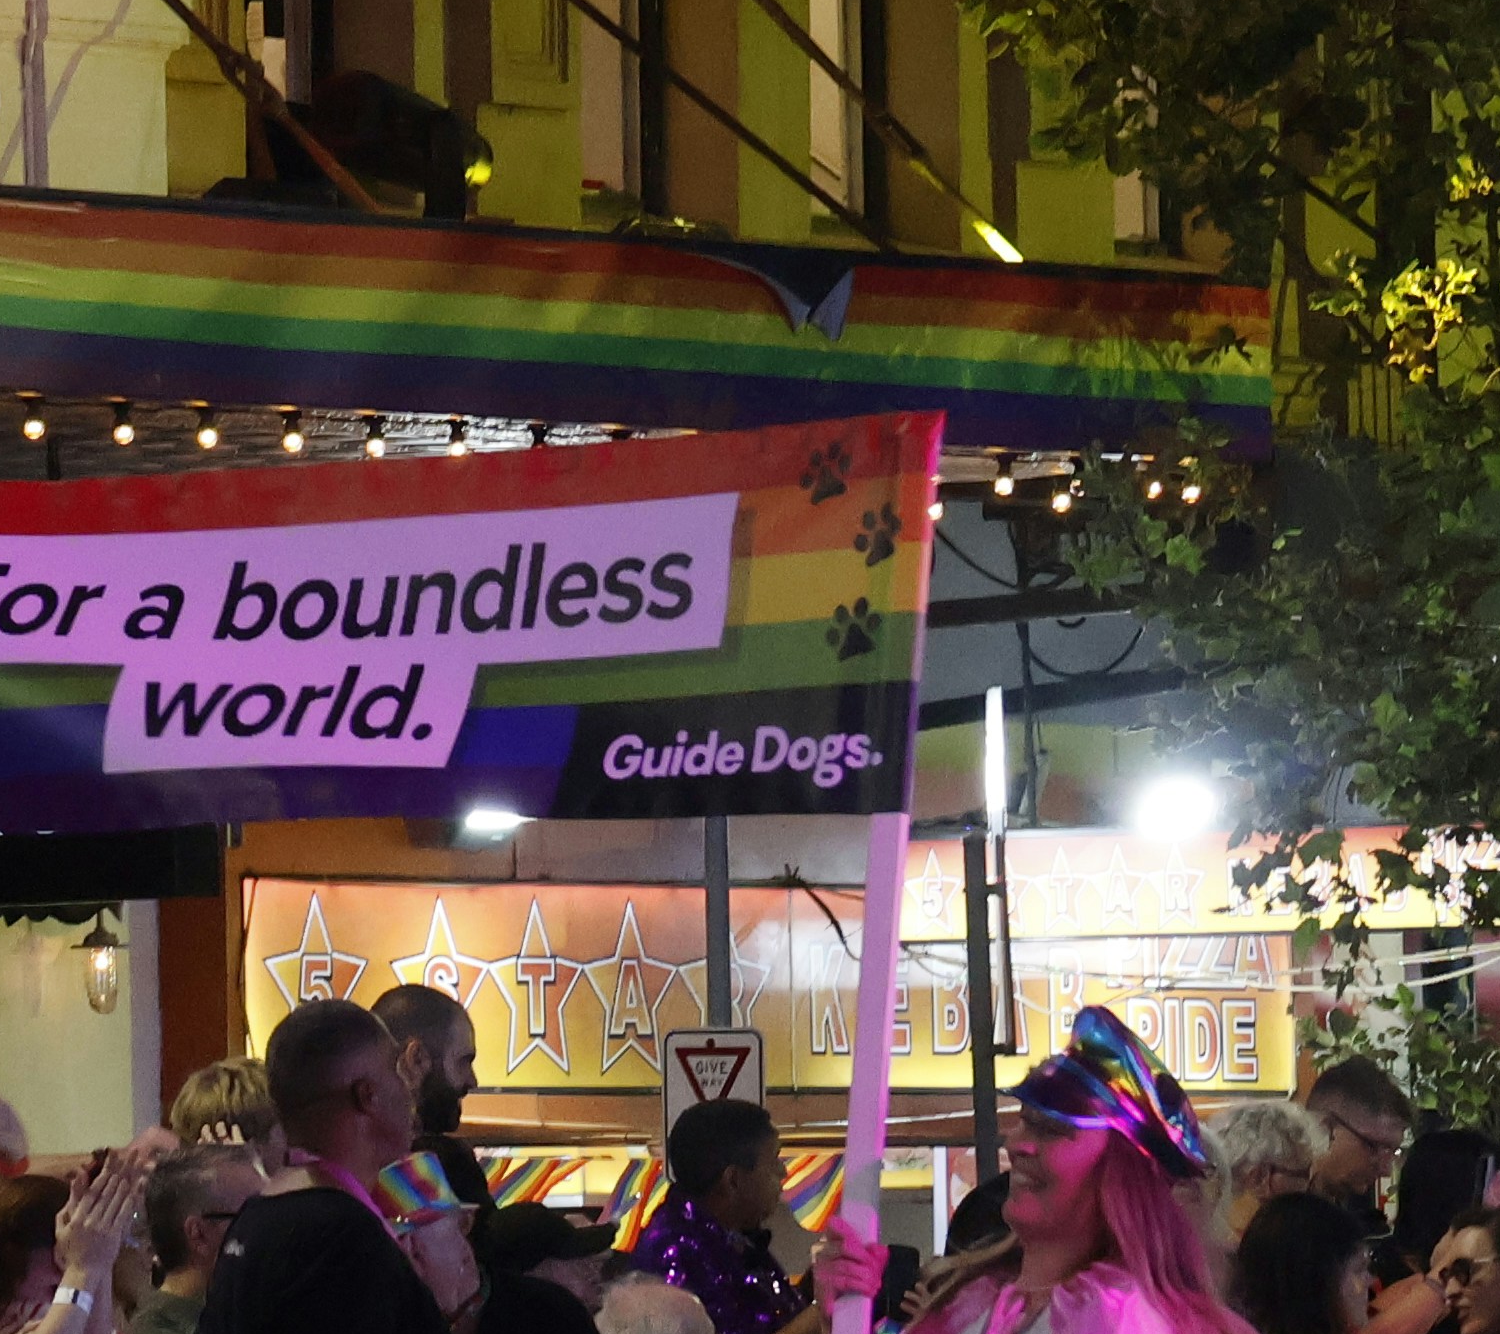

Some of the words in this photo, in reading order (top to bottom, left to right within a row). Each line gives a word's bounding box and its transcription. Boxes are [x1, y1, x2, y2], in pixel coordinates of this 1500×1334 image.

[123, 580, 184, 641] a
[212, 543, 695, 644] boundless
[143, 663, 434, 741] world.
[603, 730, 742, 780] Guide
[753, 725, 882, 789] Dogs.
[921, 876, 943, 917] 5
[695, 1061, 728, 1076] GIVE
[1125, 996, 1260, 1083] PIDE
